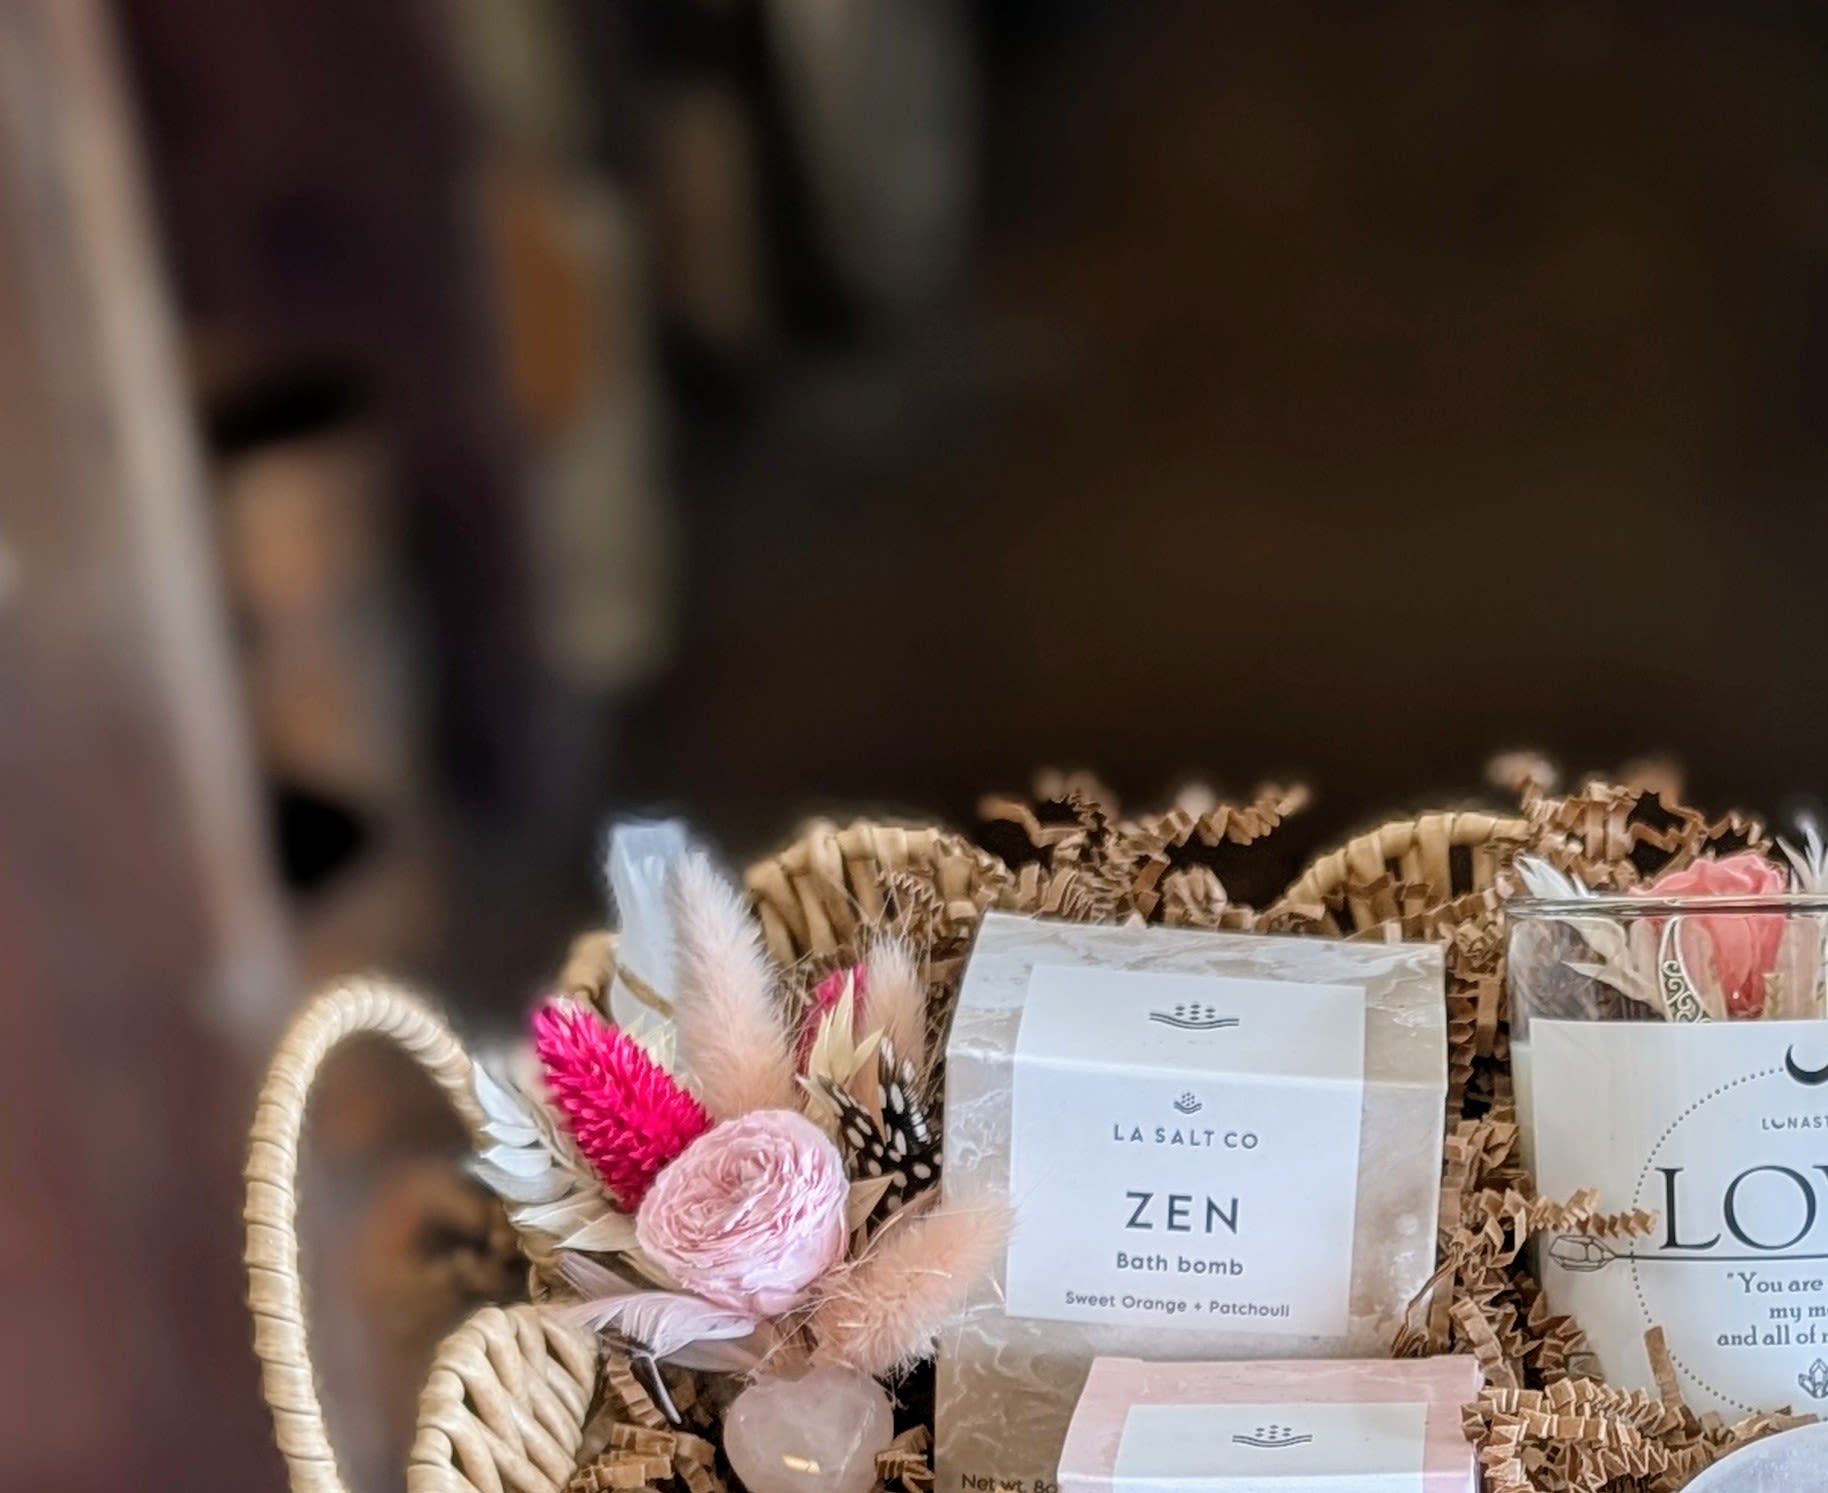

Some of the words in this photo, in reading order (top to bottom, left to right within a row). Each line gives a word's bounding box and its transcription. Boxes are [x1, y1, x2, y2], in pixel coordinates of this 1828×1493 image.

[1113, 1123, 1144, 1143] LA
[1154, 1126, 1215, 1147] SALT
[1223, 1131, 1259, 1150] CO
[1125, 1190, 1239, 1235] ZEN
[1116, 1251, 1168, 1271] Bath
[1178, 1255, 1244, 1276] bomb
[1788, 1277, 1824, 1292] are
[1065, 1290, 1115, 1307] Sweet
[1121, 1294, 1187, 1314] Orange
[1208, 1300, 1290, 1318] Patchouli
[1769, 1306, 1801, 1322] my
[1717, 1324, 1757, 1346] and
[1762, 1324, 1790, 1345] all
[1795, 1323, 1816, 1345] of
[961, 1473, 994, 1491] Net
[1000, 1478, 1027, 1493] wt.
